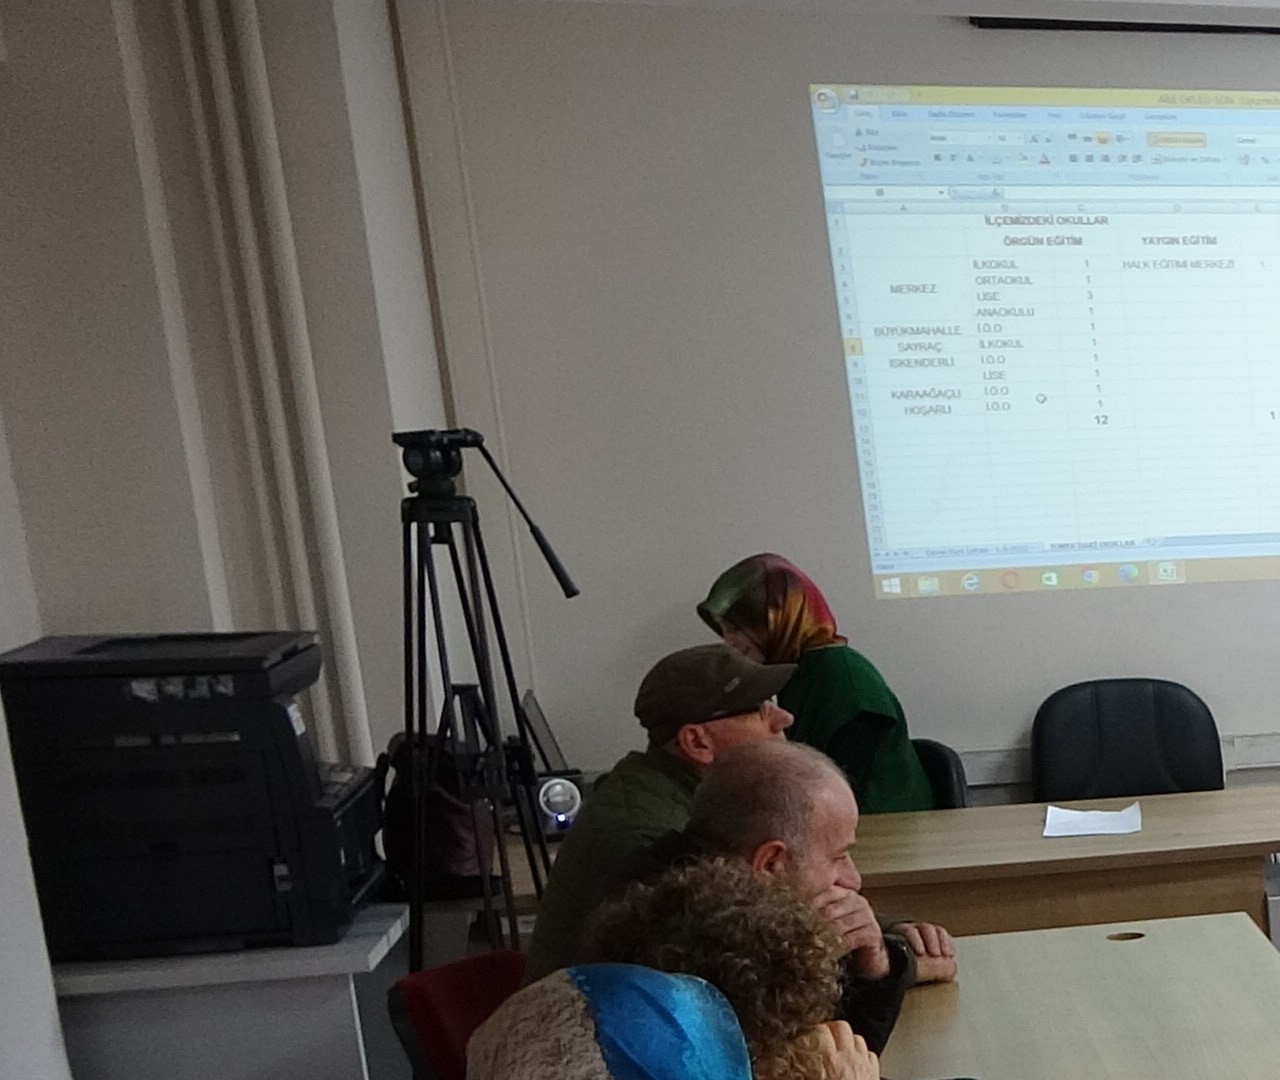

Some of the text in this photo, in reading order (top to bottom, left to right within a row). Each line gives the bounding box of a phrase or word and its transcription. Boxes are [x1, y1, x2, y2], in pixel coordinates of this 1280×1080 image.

[1055, 215, 1108, 226] OKULLAR
[1002, 235, 1043, 247] ÖRGÜN
[1094, 414, 1109, 426] 12
